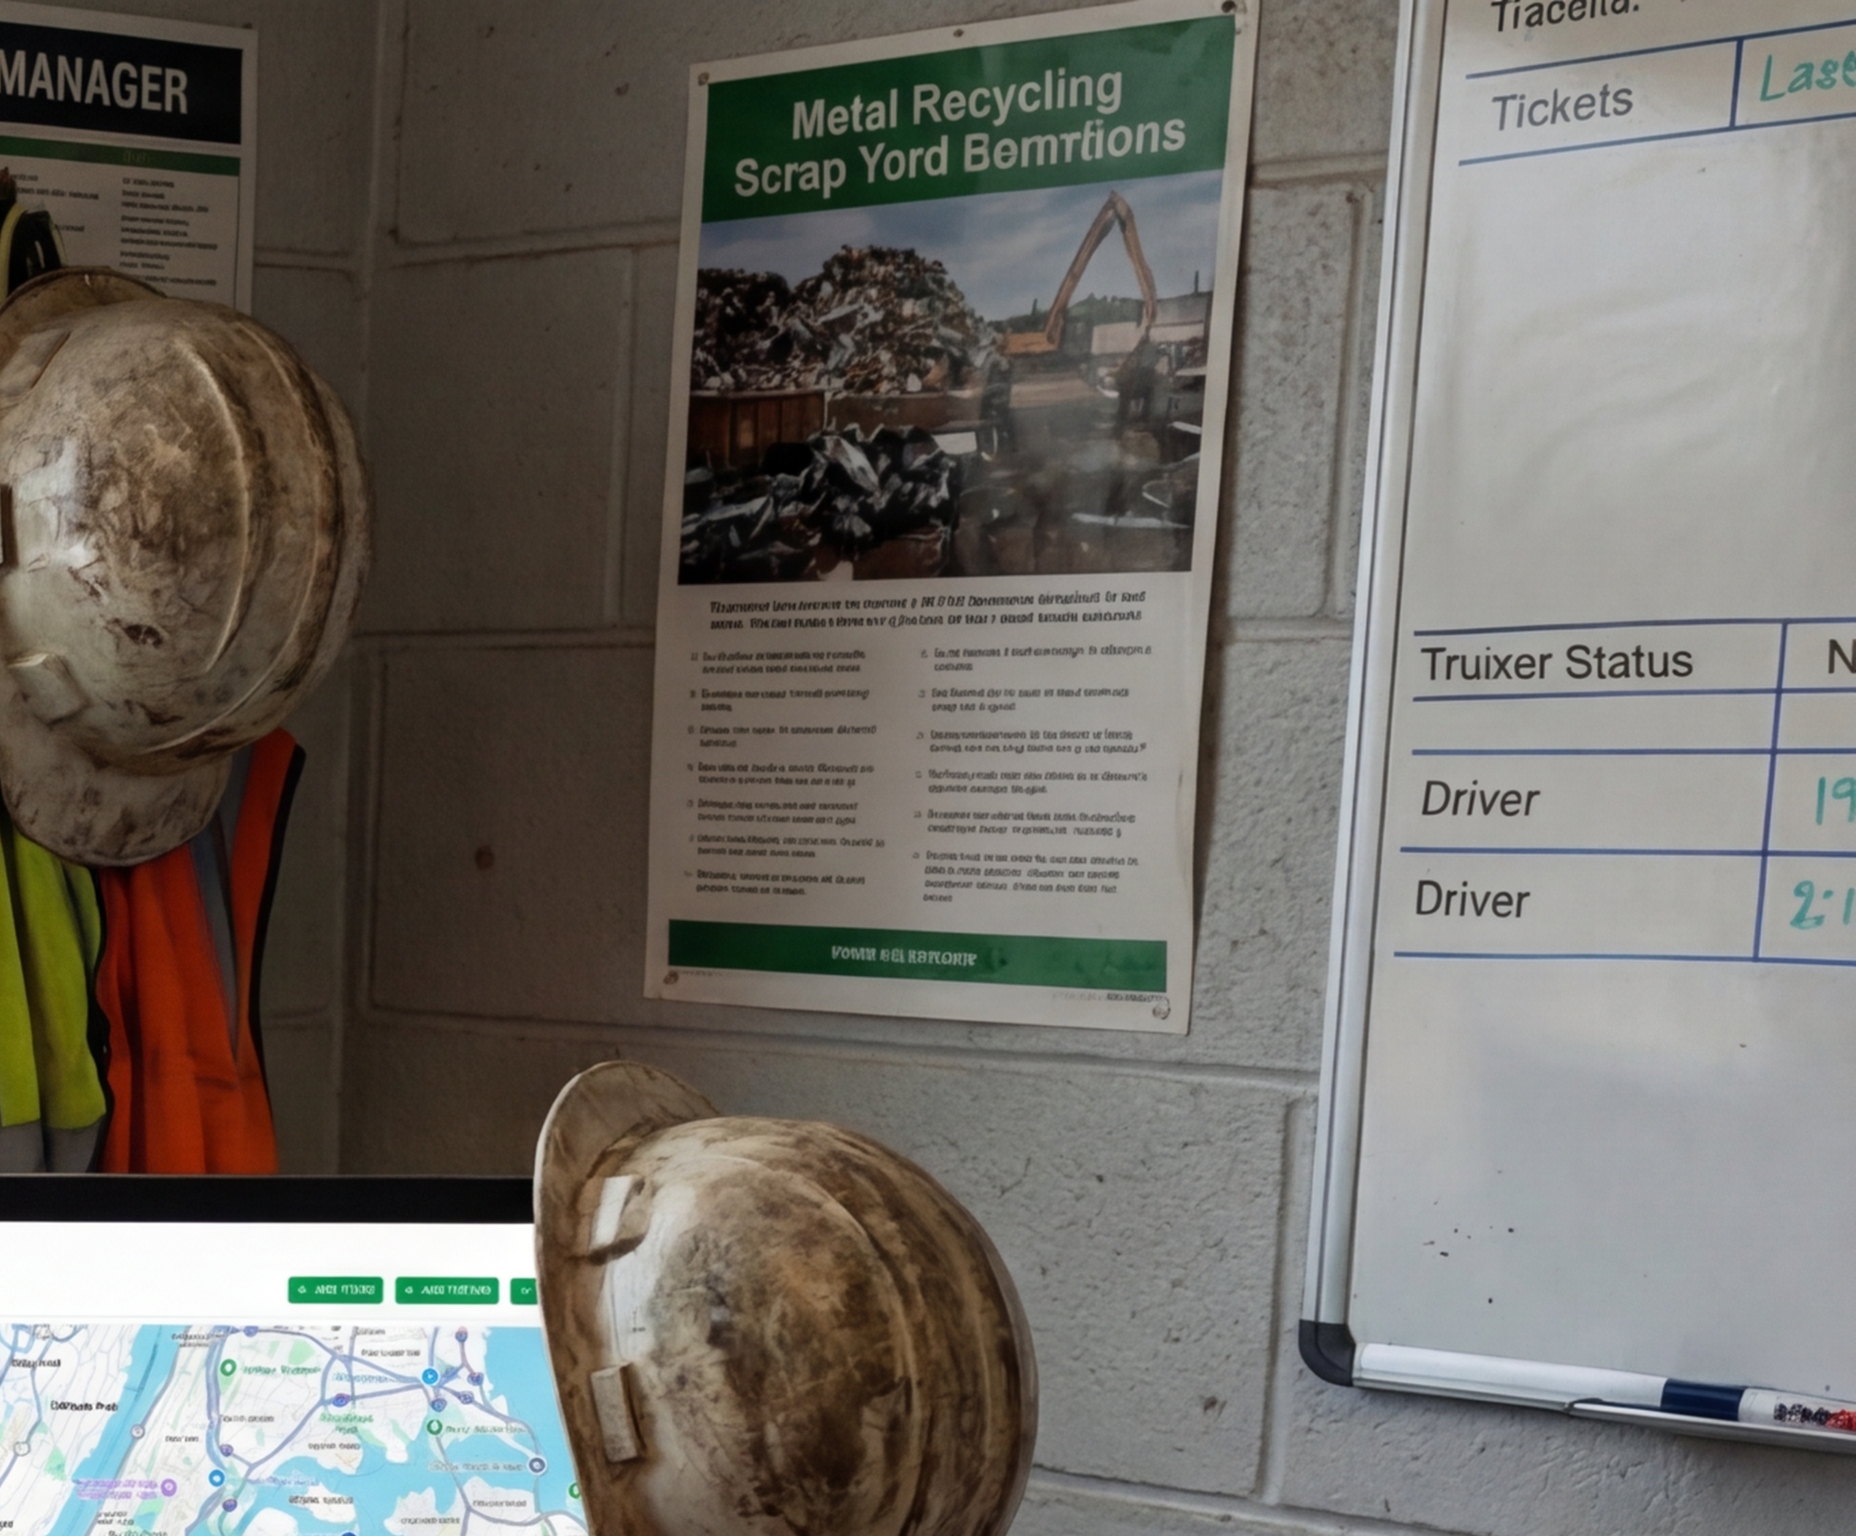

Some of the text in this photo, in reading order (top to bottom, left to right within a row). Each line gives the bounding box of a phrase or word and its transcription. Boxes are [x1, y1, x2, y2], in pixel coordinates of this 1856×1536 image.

[792, 66, 1124, 140] Metal Recycling
[1491, 84, 1634, 131] Tickets
[734, 158, 846, 200] Scrap
[858, 135, 949, 184] Yord
[1421, 644, 1694, 681] Truixer Status
[1421, 780, 1540, 816] Driver
[1415, 880, 1531, 918] Driver
